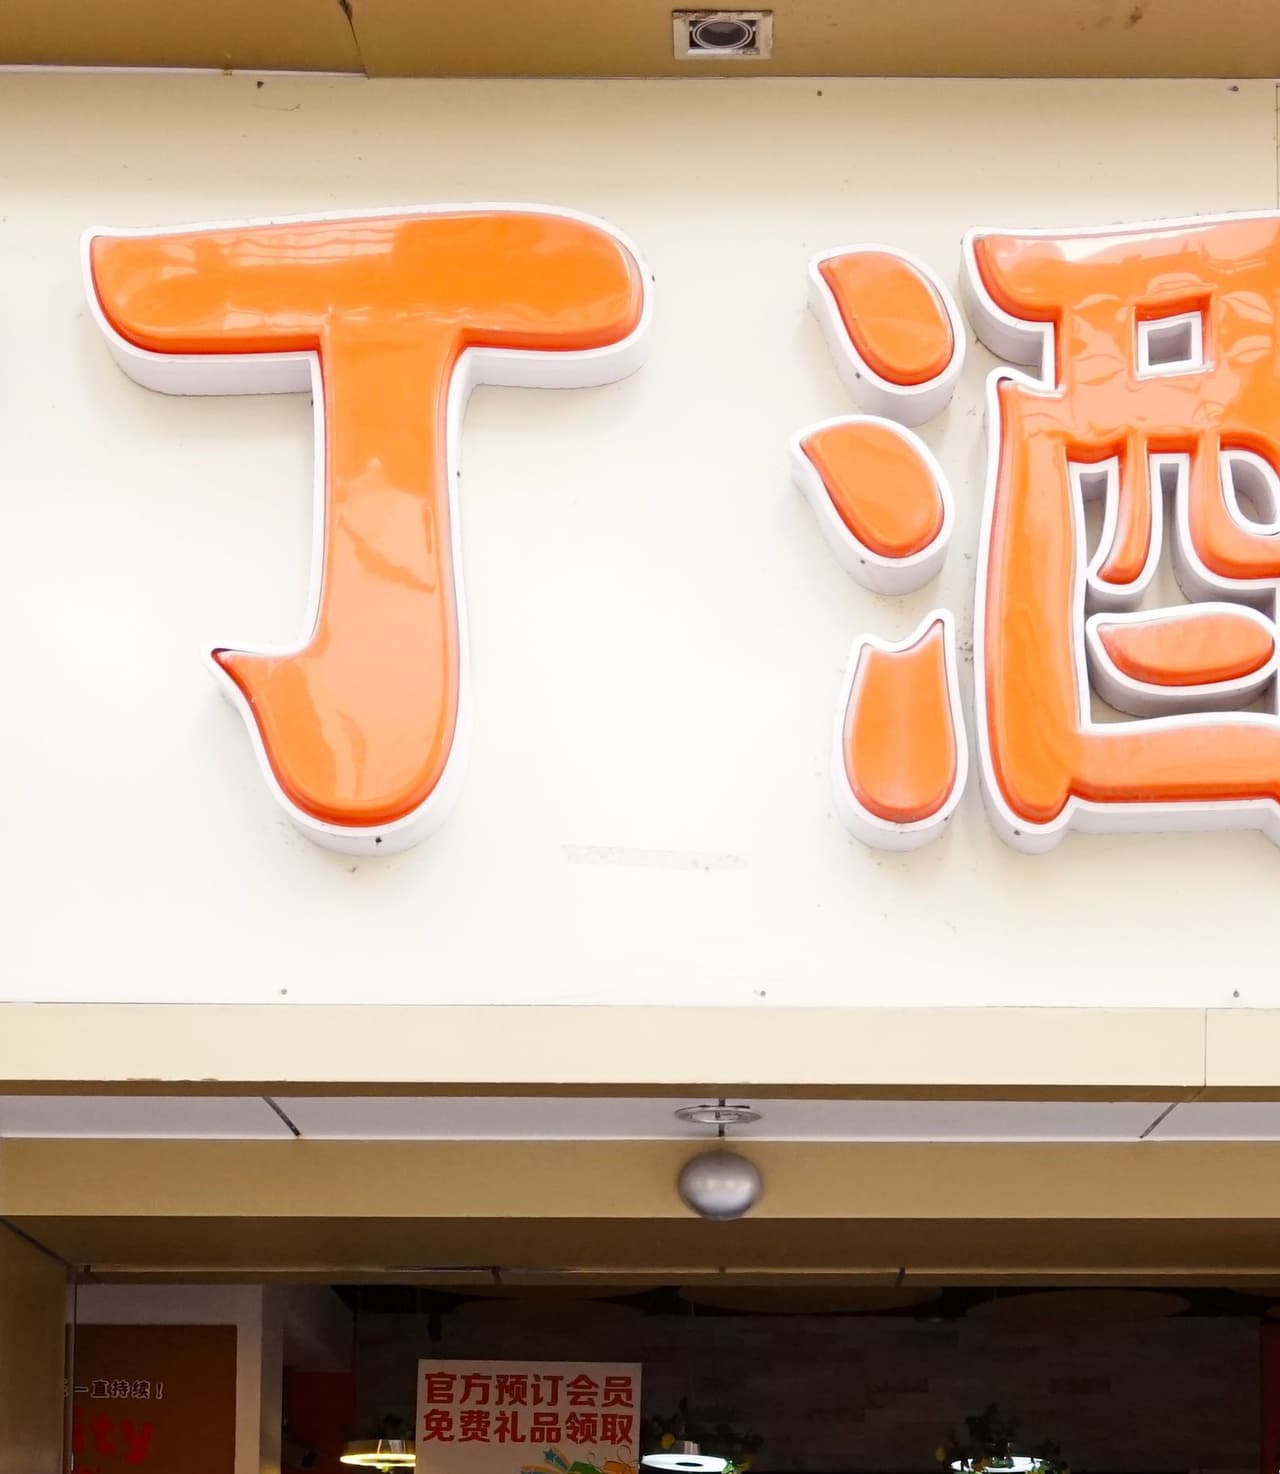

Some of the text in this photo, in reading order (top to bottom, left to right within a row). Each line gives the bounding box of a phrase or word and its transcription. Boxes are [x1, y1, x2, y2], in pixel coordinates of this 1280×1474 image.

[424, 1372, 634, 1408] 官方预订会员
[422, 1409, 634, 1445] 免费礼品领取
